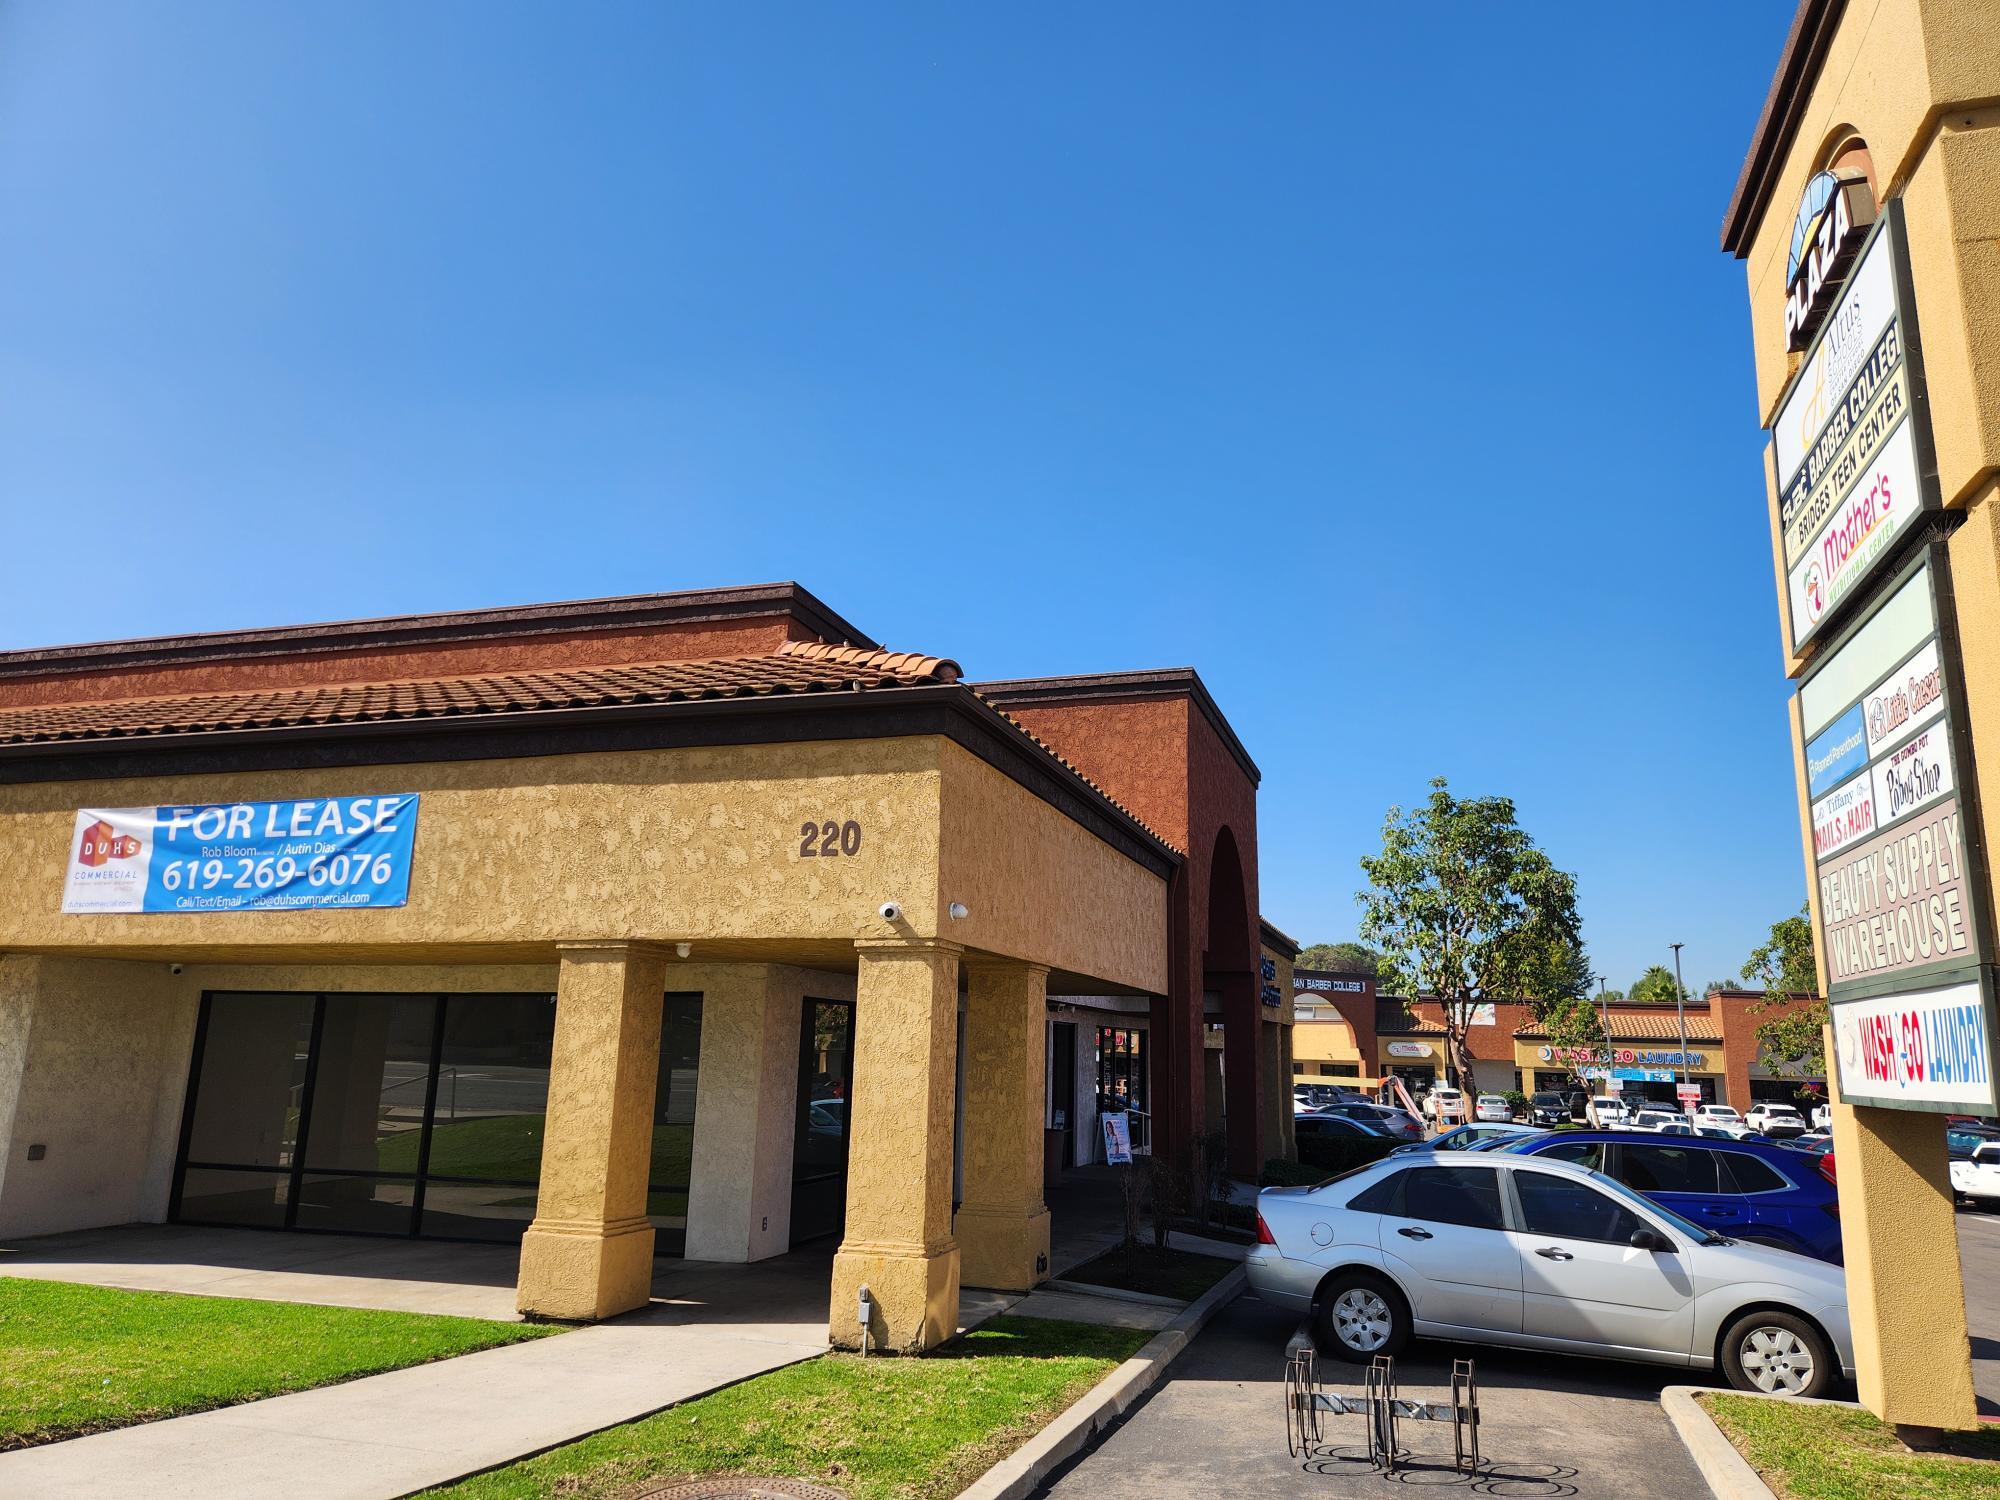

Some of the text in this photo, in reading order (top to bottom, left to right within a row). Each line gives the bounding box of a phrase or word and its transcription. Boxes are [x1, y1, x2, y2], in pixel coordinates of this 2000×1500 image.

[1784, 185, 1851, 352] PLAZA
[1828, 292, 1860, 367] Altus
[1799, 382, 1901, 545] BRIDGES TEEN CENTER
[1808, 404, 1849, 487] BARBER
[1868, 517, 1895, 558] CENTER
[1884, 686, 1909, 733] Little
[1891, 734, 1928, 768] THE GUMBO POT
[1914, 757, 1940, 800] Shop
[168, 797, 400, 841] FOR LEASE
[1826, 788, 1854, 814] Tiffany
[84, 841, 136, 855] DUHS
[800, 820, 862, 857] 220
[1815, 817, 1842, 855] NAILS
[1847, 800, 1872, 838] HAIR
[202, 847, 221, 858] Rob
[224, 845, 257, 857] Bloom
[284, 843, 311, 855] Autin
[314, 842, 337, 854] Dias
[1820, 813, 1960, 927] BEAUTY SUPPLY
[75, 870, 137, 880] COMMERCIAL
[162, 853, 392, 891] 619-269-6076
[176, 895, 242, 908] Call/Text/Email
[250, 892, 370, 907] rob@duhscommercial.com
[1831, 887, 1967, 978] WAREHOUSE
[1306, 979, 1331, 991] BARBER
[1333, 981, 1361, 992] COLLEGE
[1637, 1051, 1702, 1066] LAUNDRY
[1858, 1014, 1898, 1082] WASH
[1902, 1010, 1924, 1082] GO
[1923, 1004, 1987, 1084] LAUNDRY
